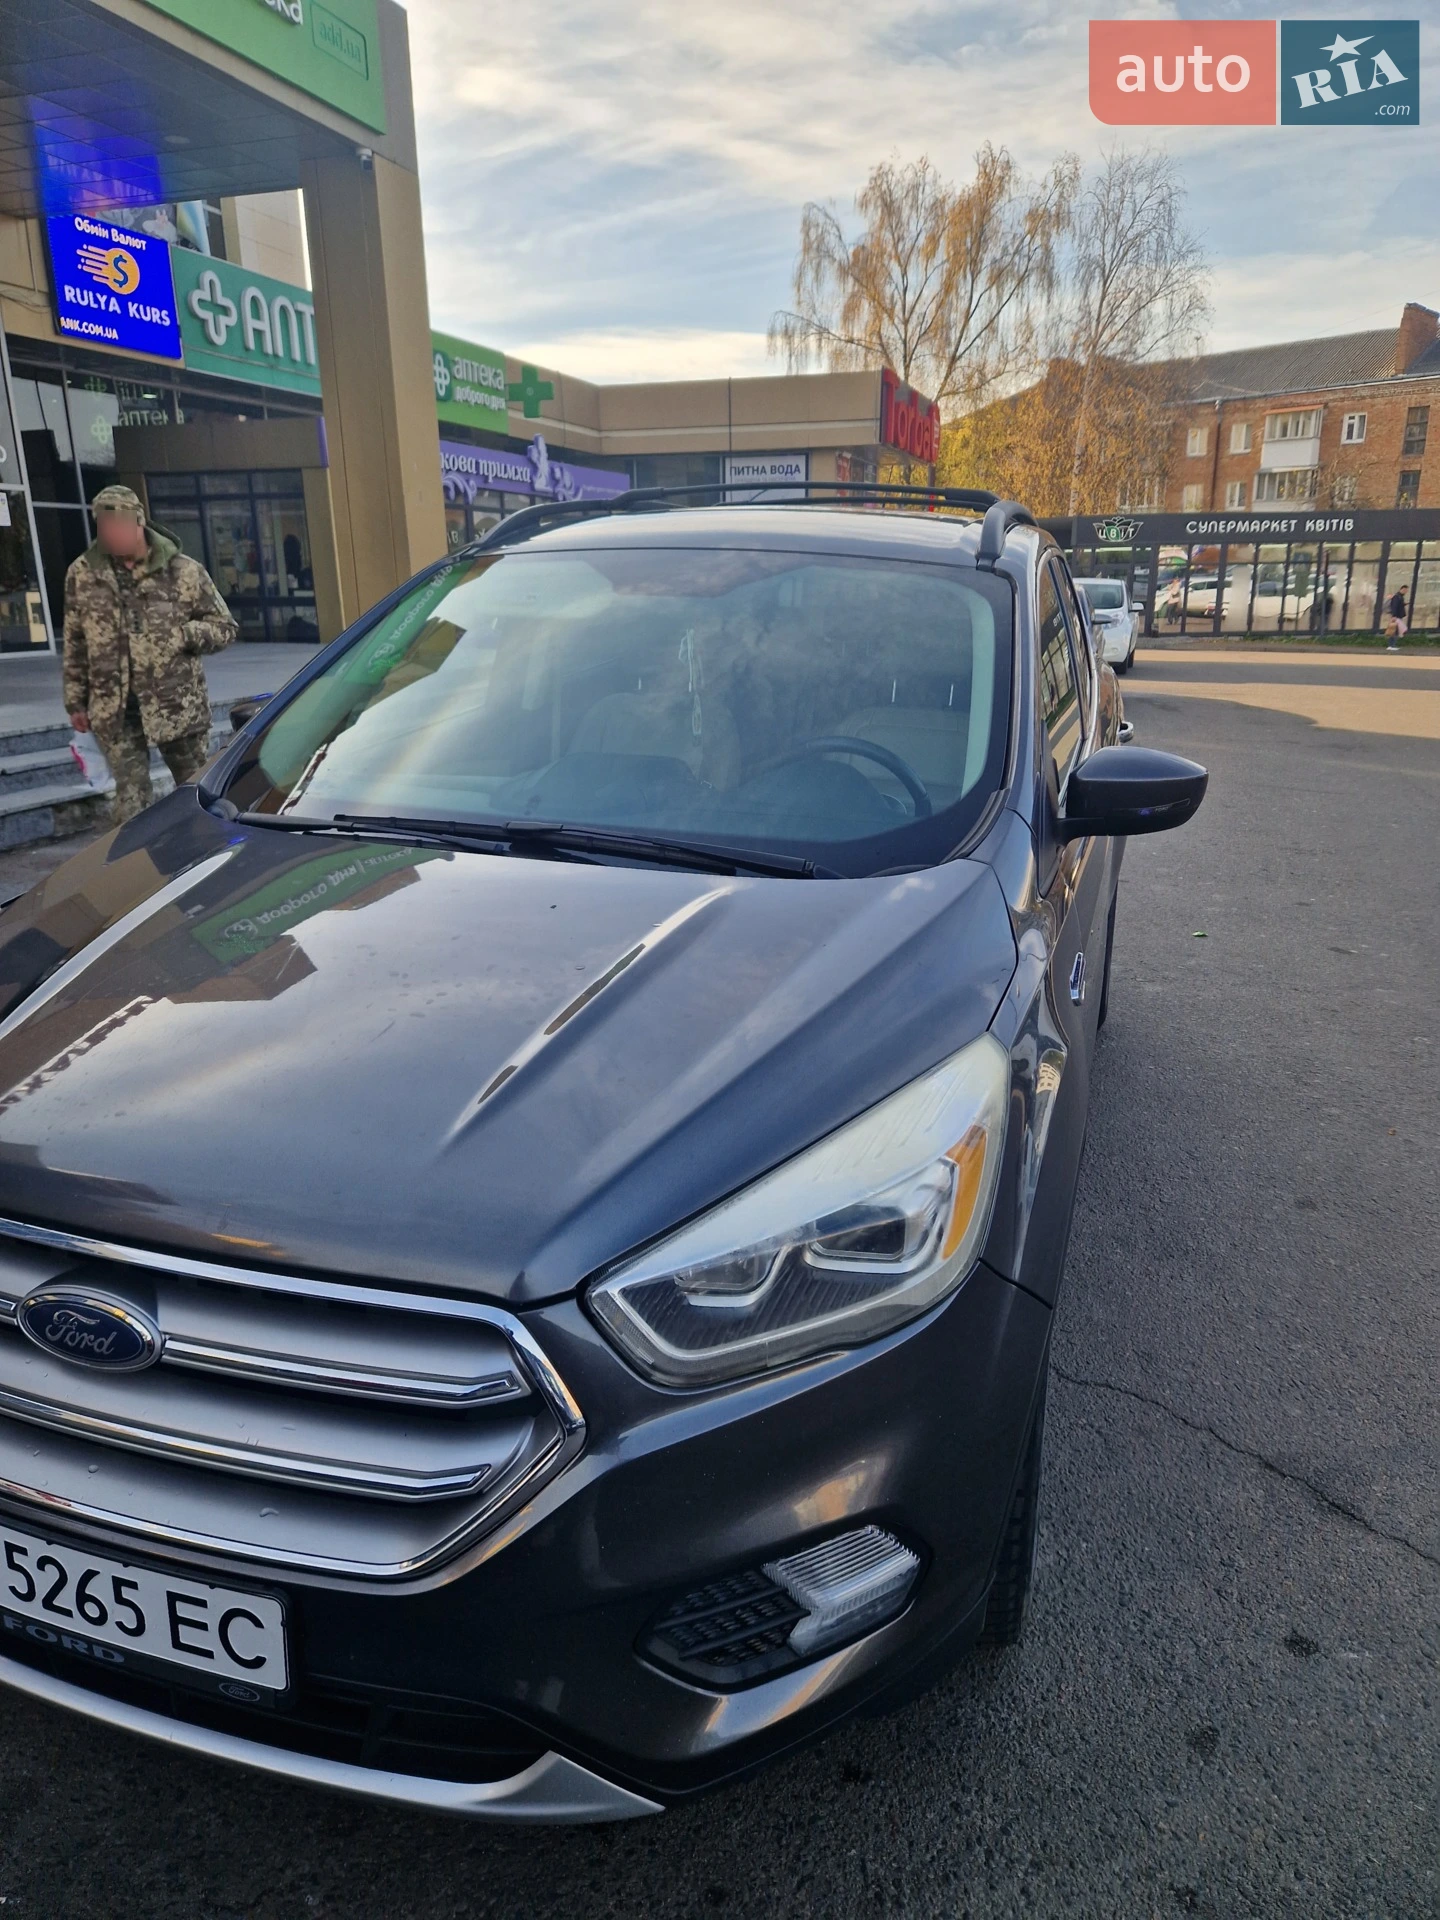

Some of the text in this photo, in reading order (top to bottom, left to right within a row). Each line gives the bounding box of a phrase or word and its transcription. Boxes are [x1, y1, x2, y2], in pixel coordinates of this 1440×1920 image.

[74, 217, 146, 250] Обмін Валют
[64, 285, 171, 326] RULYA KURS
[453, 356, 504, 390] аптека
[478, 459, 532, 483] примха
[730, 464, 802, 476] ПИТНА ВОДА
[1186, 518, 1355, 533] СУПЕРМАРКЕТ КВІТІВ
[45, 1309, 118, 1355] Ford
[4, 1540, 267, 1669] 5265 EC
[3, 1614, 125, 1663] FORD
